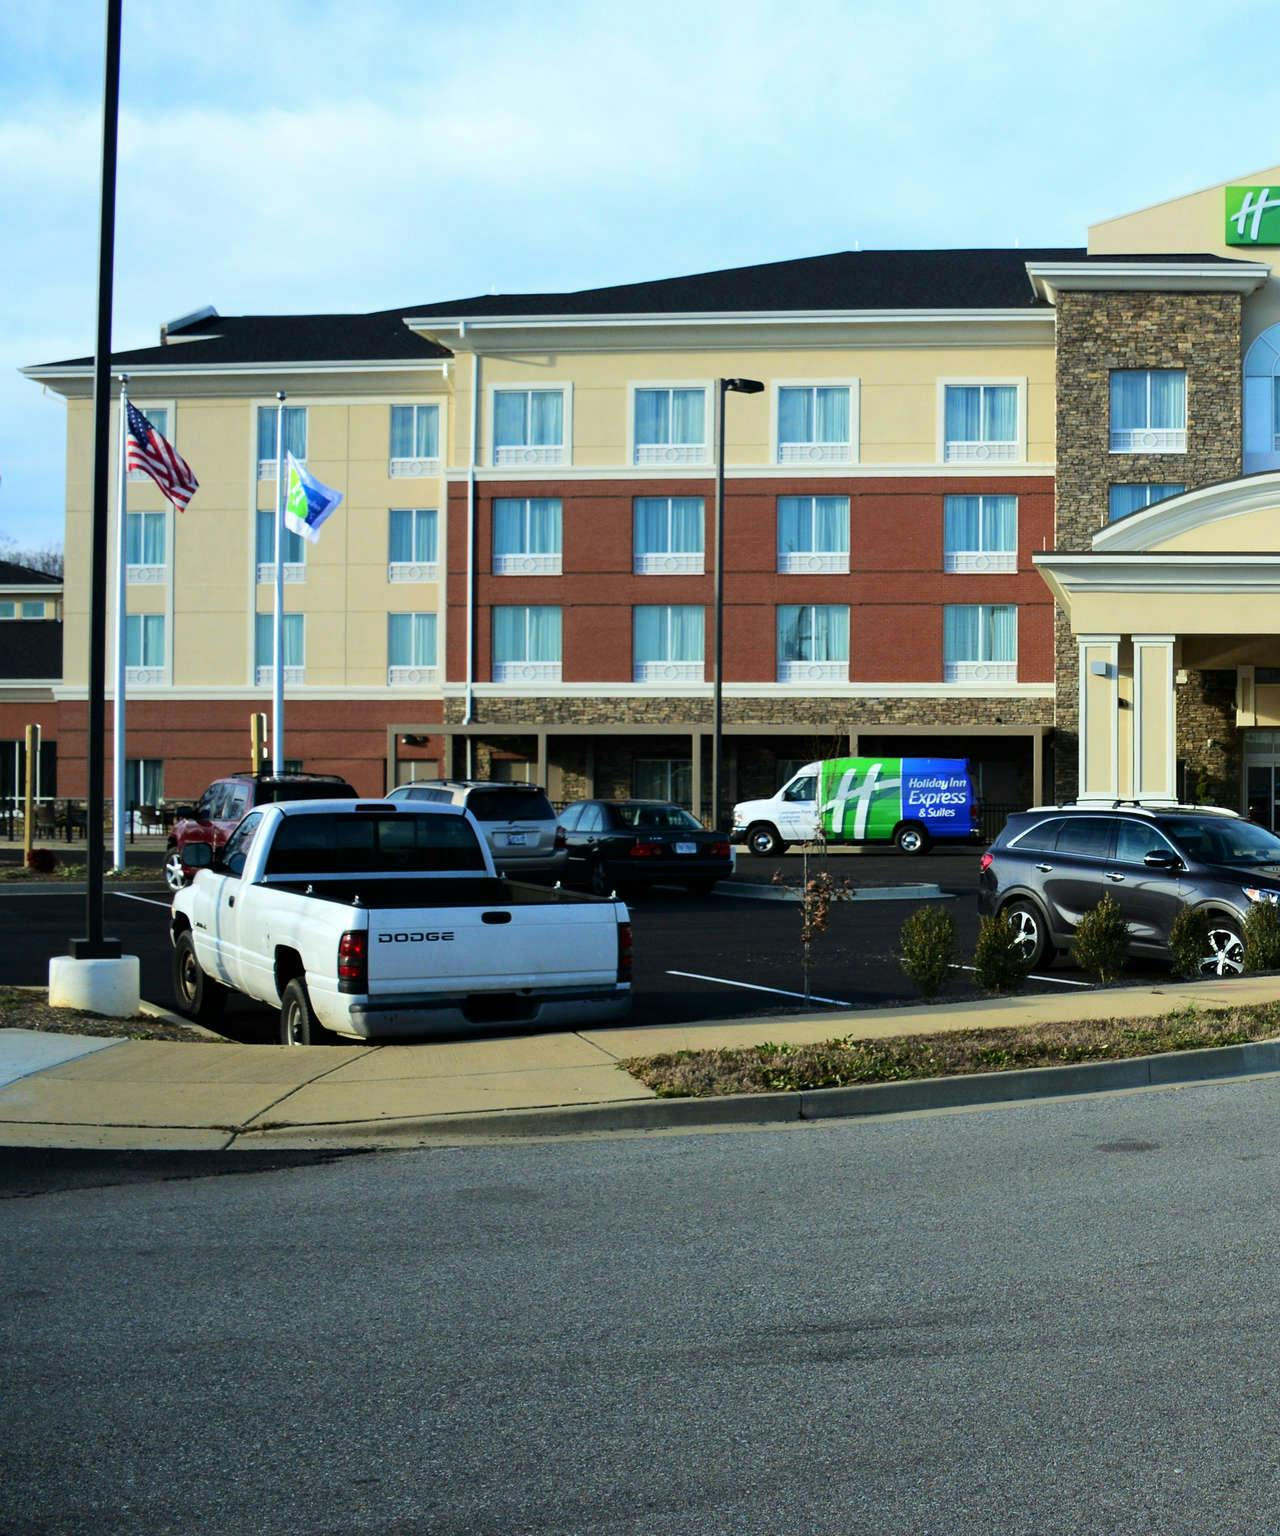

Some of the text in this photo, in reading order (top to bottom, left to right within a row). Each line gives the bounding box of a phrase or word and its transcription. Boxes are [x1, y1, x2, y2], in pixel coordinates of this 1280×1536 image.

[909, 777, 967, 790] Holiday Inn
[908, 790, 967, 808] Express
[918, 807, 956, 818] & Suites
[378, 931, 455, 944] DODGE
